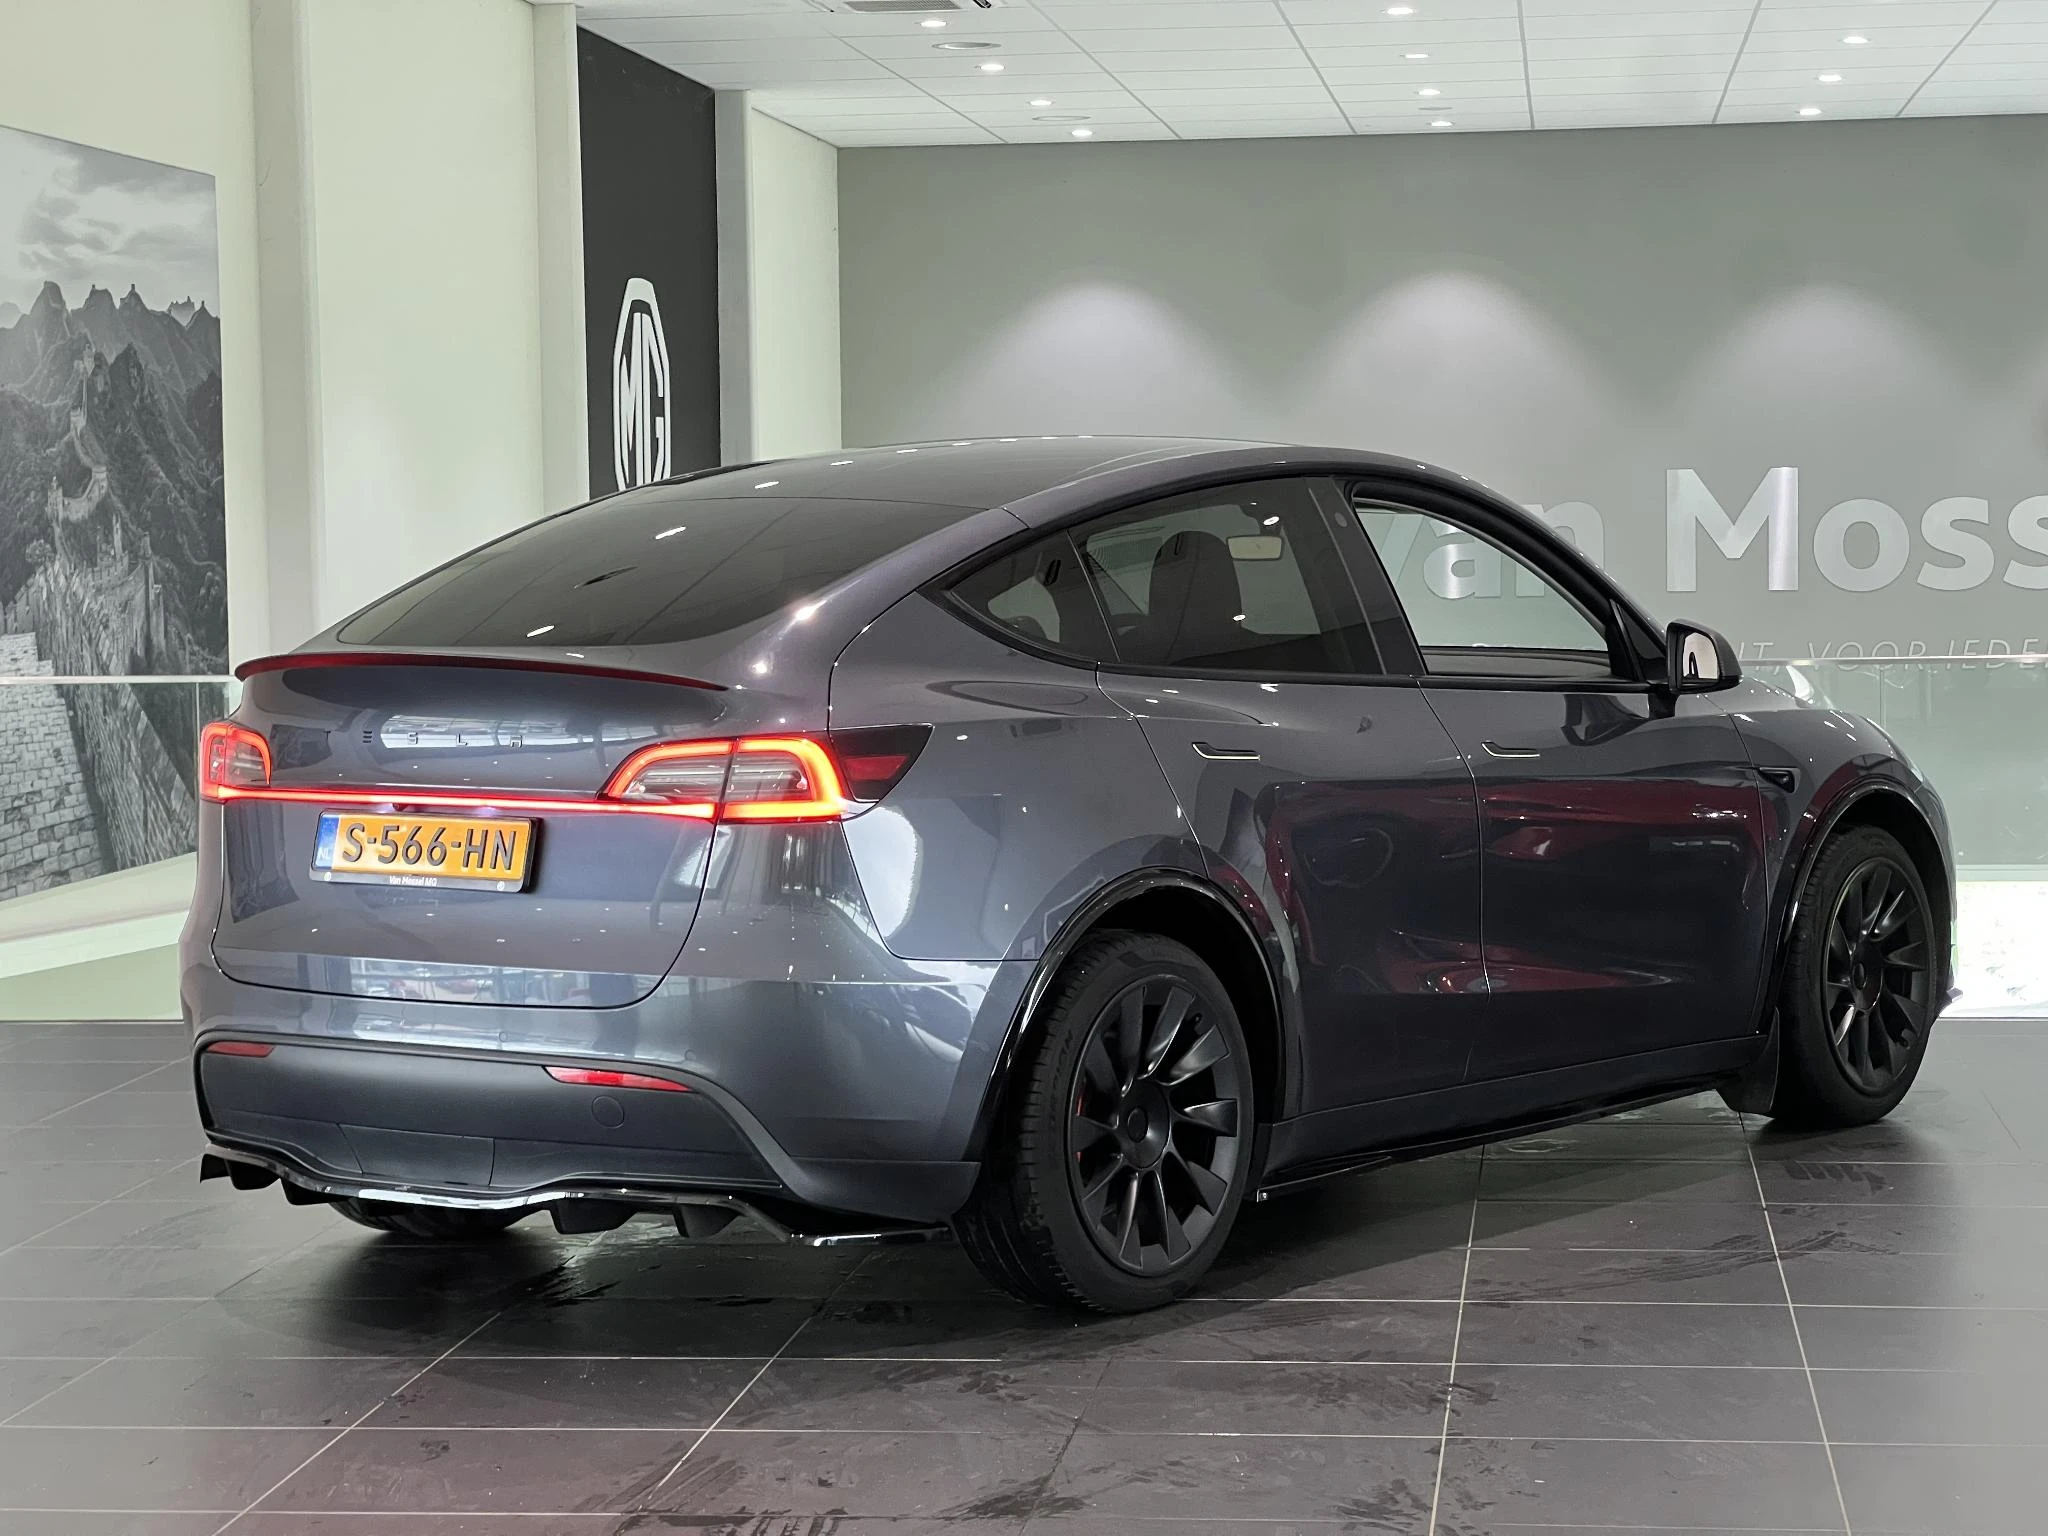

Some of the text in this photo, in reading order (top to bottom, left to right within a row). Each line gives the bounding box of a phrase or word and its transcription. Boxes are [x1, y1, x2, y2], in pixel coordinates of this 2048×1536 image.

[619, 312, 666, 486] MG
[1666, 466, 2048, 591] Moss
[1807, 640, 1926, 671] VOOR
[1946, 638, 2048, 670] IEDE
[323, 730, 523, 748] TESLA
[318, 822, 517, 871] NL S-566-HN
